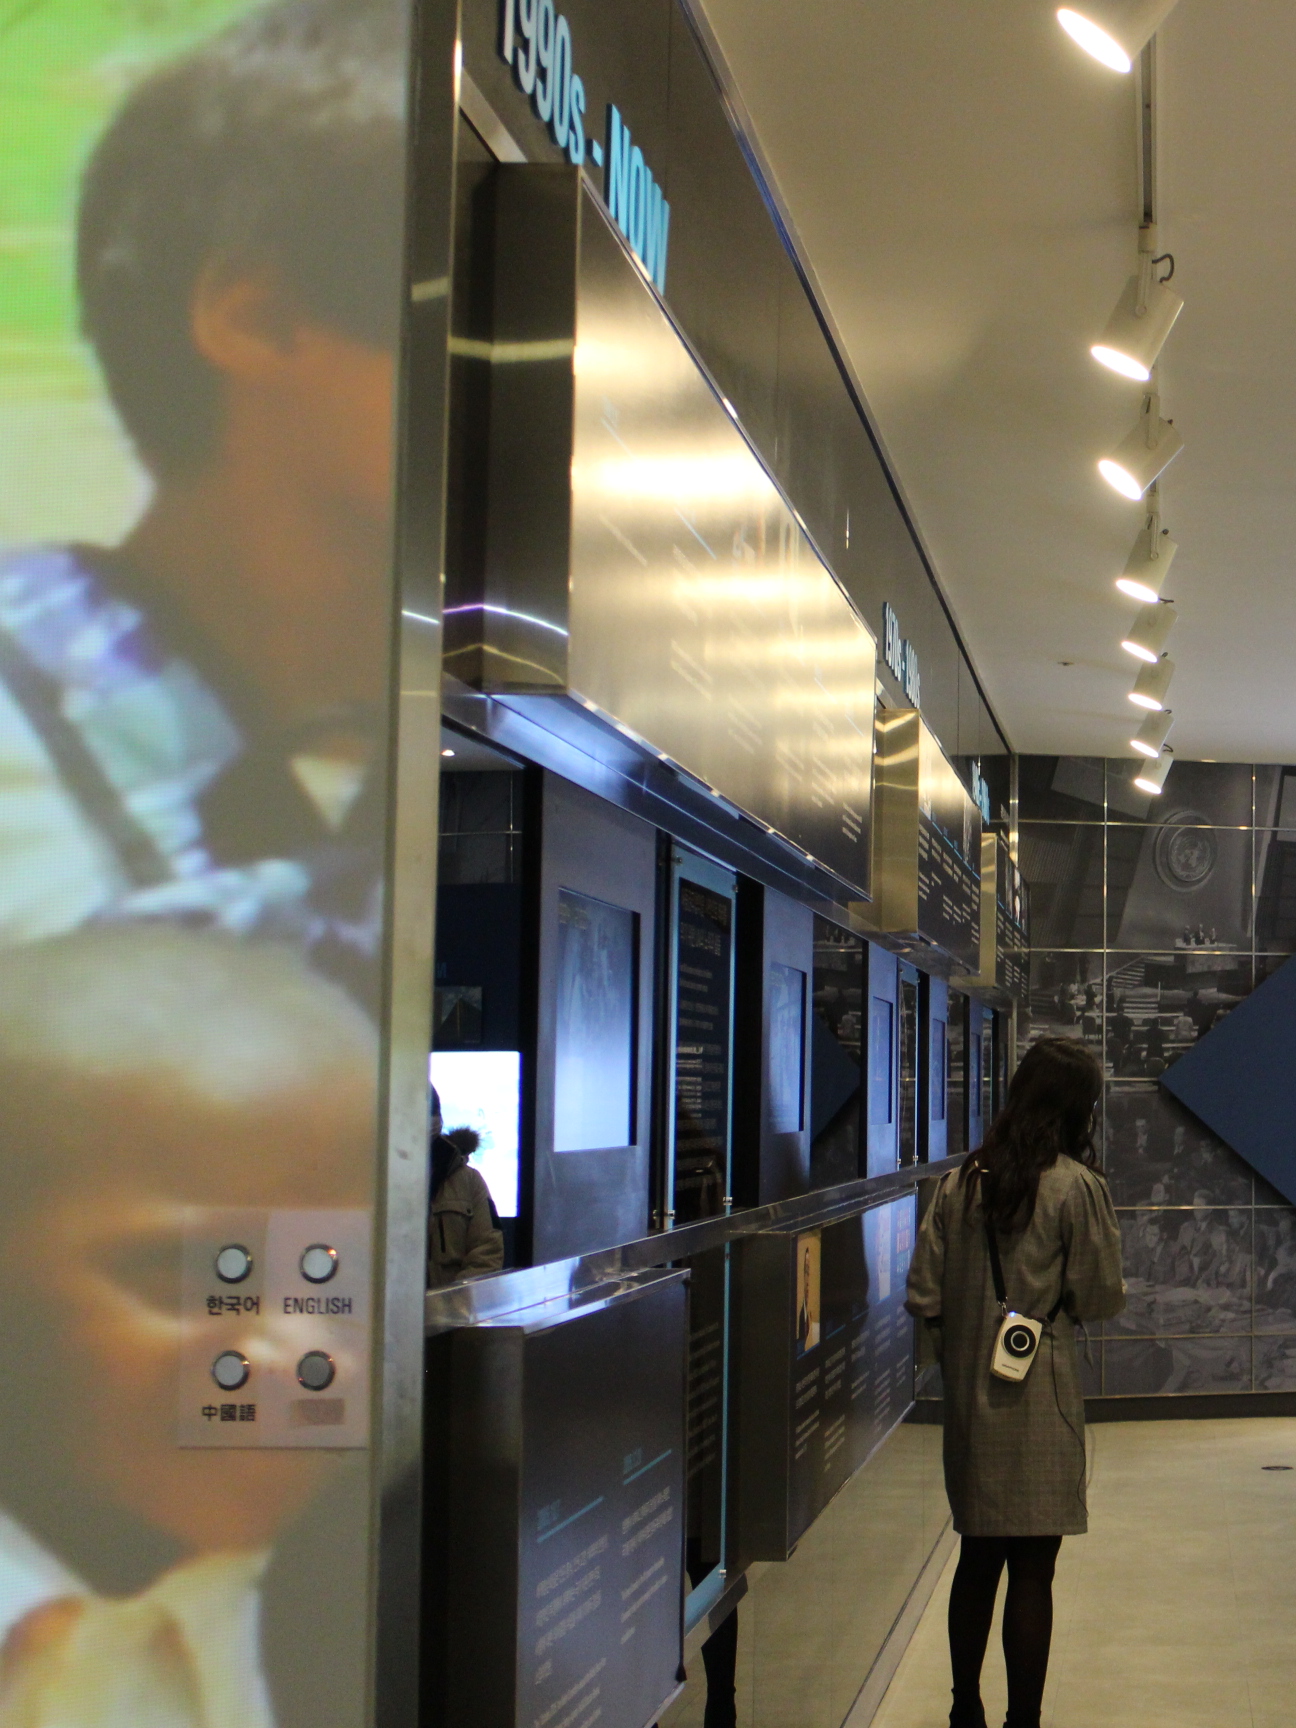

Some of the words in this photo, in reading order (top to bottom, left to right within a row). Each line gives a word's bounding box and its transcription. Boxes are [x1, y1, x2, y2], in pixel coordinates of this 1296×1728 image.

[608, 103, 671, 297] NOW
[206, 1295, 261, 1316] 한국어
[283, 1297, 352, 1314] ENGLISH
[202, 1404, 256, 1422] 中國語
